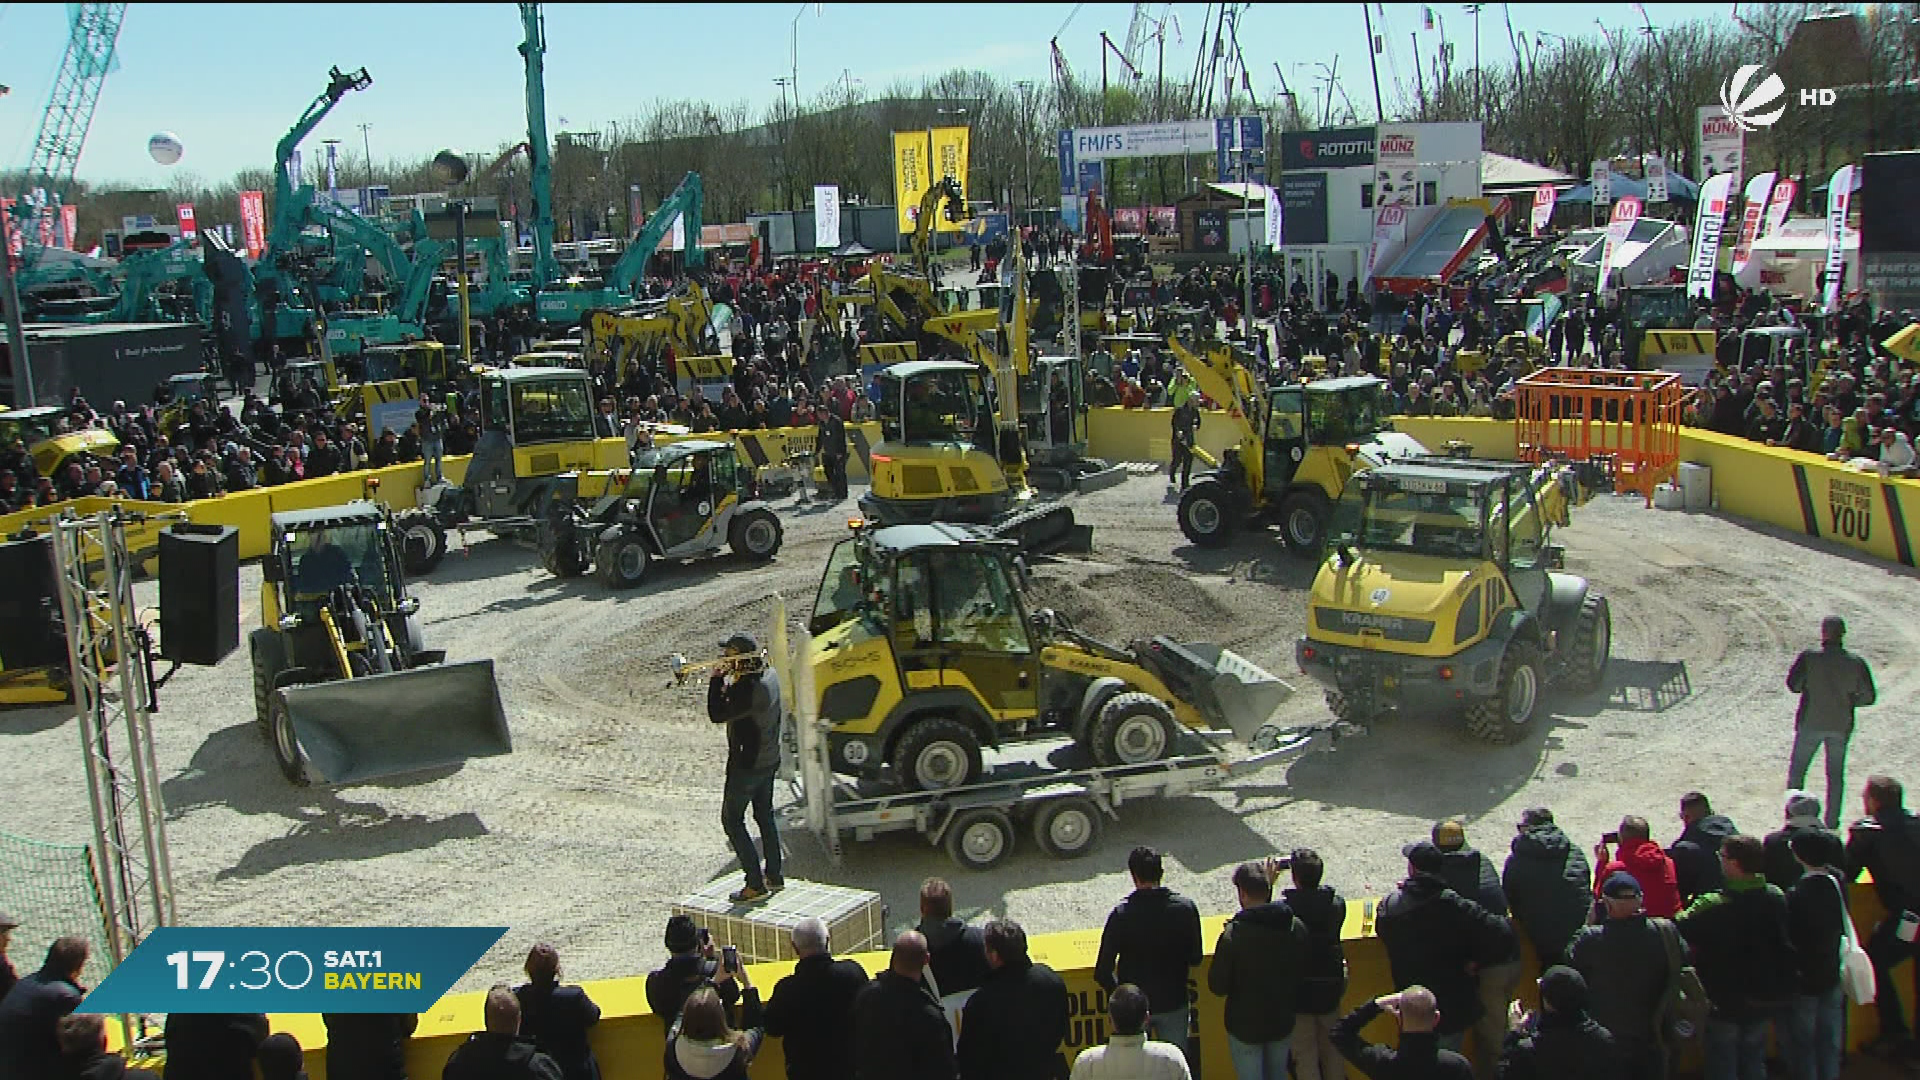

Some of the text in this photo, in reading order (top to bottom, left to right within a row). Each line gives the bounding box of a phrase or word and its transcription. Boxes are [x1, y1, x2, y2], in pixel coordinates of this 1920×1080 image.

[1079, 134, 1123, 152] FM/FS
[1318, 141, 1375, 156] ROTOTIL
[1380, 137, 1415, 152] MÜNZ
[1539, 190, 1551, 202] M
[1618, 203, 1634, 216] M
[1829, 479, 1872, 498] SOLUTIONS
[1829, 491, 1871, 510] BUILT FOR
[1830, 504, 1871, 541] YOU
